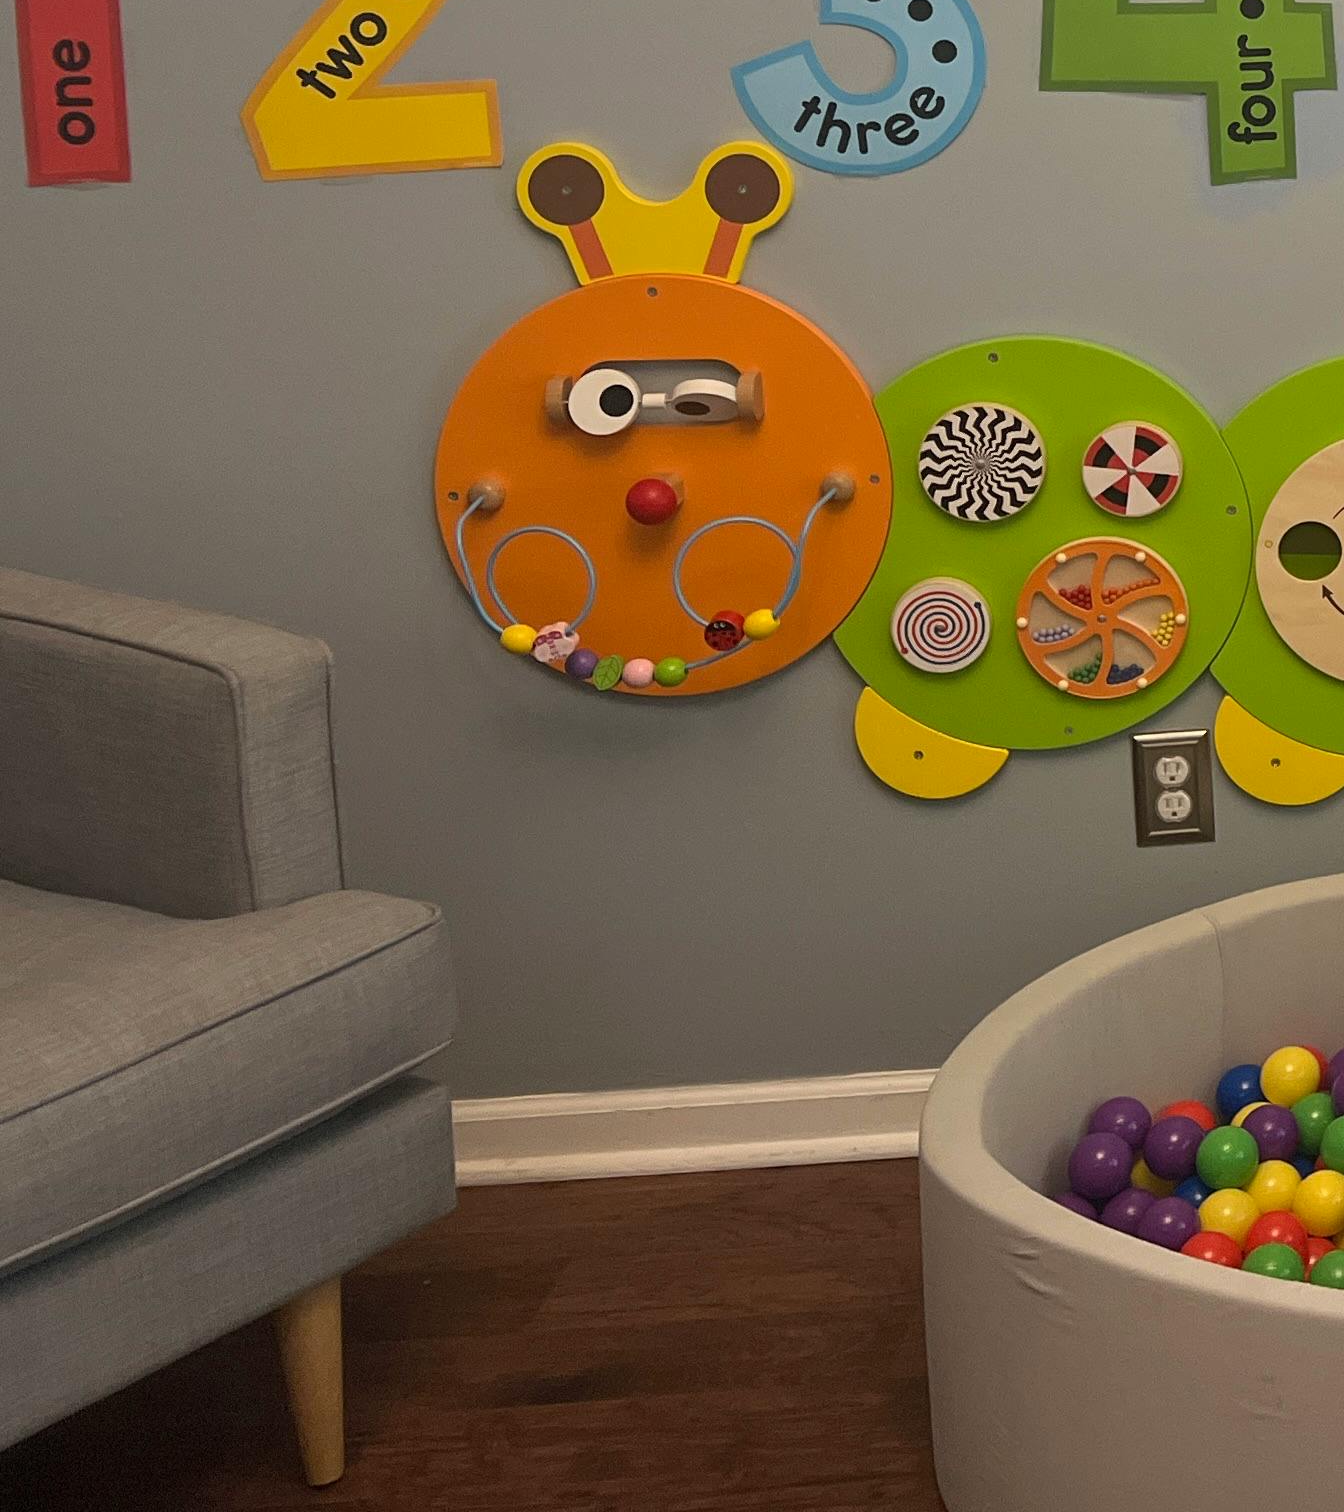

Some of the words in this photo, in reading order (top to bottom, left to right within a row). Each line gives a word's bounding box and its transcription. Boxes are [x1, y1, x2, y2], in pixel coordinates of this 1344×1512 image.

[53, 37, 96, 145] one
[296, 11, 388, 100] two
[1228, 33, 1278, 144] four
[794, 85, 946, 155] three
